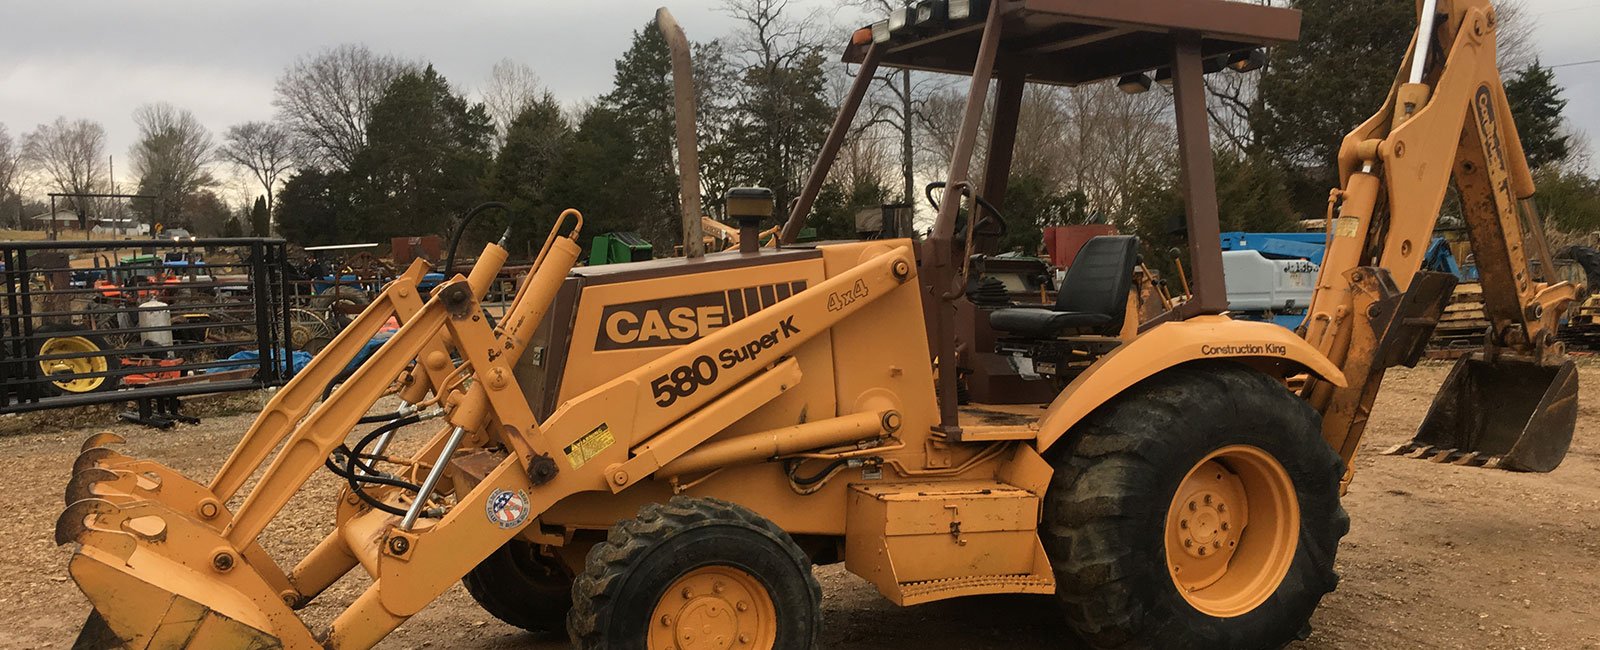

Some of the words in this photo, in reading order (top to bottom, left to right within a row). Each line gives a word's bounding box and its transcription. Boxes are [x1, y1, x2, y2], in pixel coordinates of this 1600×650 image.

[827, 278, 869, 312] 4x4
[605, 305, 725, 344] CASE
[650, 355, 719, 408] 580
[718, 329, 780, 369] Super
[779, 315, 801, 339] K
[1201, 344, 1264, 356] Construction
[1265, 344, 1286, 356] King
